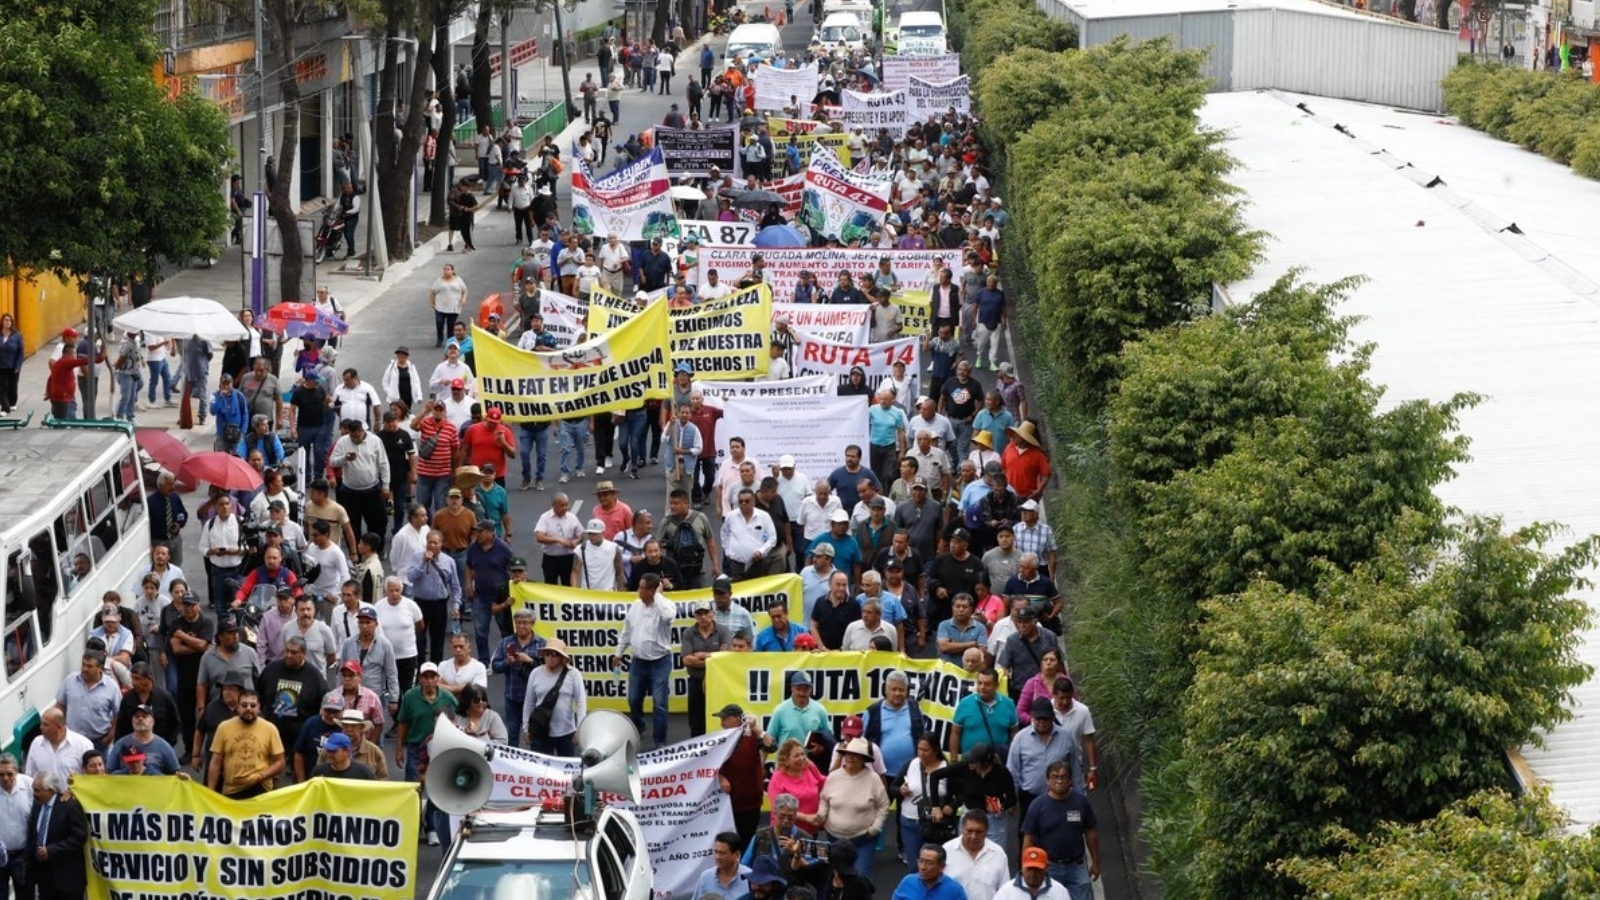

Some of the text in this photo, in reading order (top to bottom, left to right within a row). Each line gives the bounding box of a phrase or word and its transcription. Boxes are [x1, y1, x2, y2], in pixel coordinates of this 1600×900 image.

[867, 93, 906, 107] RUTA 43
[917, 98, 927, 108] DEL
[844, 110, 873, 123] PRESENTE
[875, 111, 879, 123] Y
[880, 111, 887, 123] EN
[813, 174, 873, 205] RUTA 43
[719, 226, 750, 245] 87
[710, 250, 747, 260] CLARA
[804, 251, 848, 261] MOLINA,
[851, 251, 878, 260] JEFA
[831, 261, 866, 269] JUSTO
[868, 261, 876, 269] A
[894, 261, 932, 269] TARIFA
[773, 270, 841, 278] TRANORTE
[675, 312, 743, 334] EXIGIMOS
[796, 311, 812, 326] UN
[813, 311, 868, 327] AUMENTO
[680, 333, 764, 352] DE NUESTRA
[671, 355, 756, 373] RECHOS !!
[803, 341, 914, 368] RUTA 14
[482, 377, 493, 393] !!
[495, 378, 516, 396] LA
[517, 377, 546, 396] FAT
[549, 375, 570, 394] EN
[572, 372, 597, 393] PIE
[599, 364, 618, 385] DE
[518, 399, 553, 416] UNA
[554, 389, 612, 415] TARIFA
[657, 372, 668, 389] !!
[702, 385, 828, 397] RUTA 47 PRESENTE
[539, 603, 558, 621] EL
[561, 602, 632, 622] SERVICI
[556, 629, 618, 648] HEMOS
[571, 654, 631, 673] ERNOS
[748, 669, 769, 701] !!
[494, 773, 515, 783] EFA
[518, 775, 534, 785] DE
[536, 777, 572, 787] GOBIE
[680, 771, 693, 781] DE
[696, 768, 719, 778] MEX
[510, 785, 565, 798] CLAR
[107, 808, 162, 842] MÁS
[166, 814, 195, 842] DE
[199, 816, 233, 845] 40
[238, 814, 307, 847] AÑOS
[313, 812, 400, 848] DANDO
[668, 852, 690, 862] AÑO
[691, 848, 714, 859] 2022
[90, 848, 407, 888] SERVICIO Y SIN SUBSIDIOS
